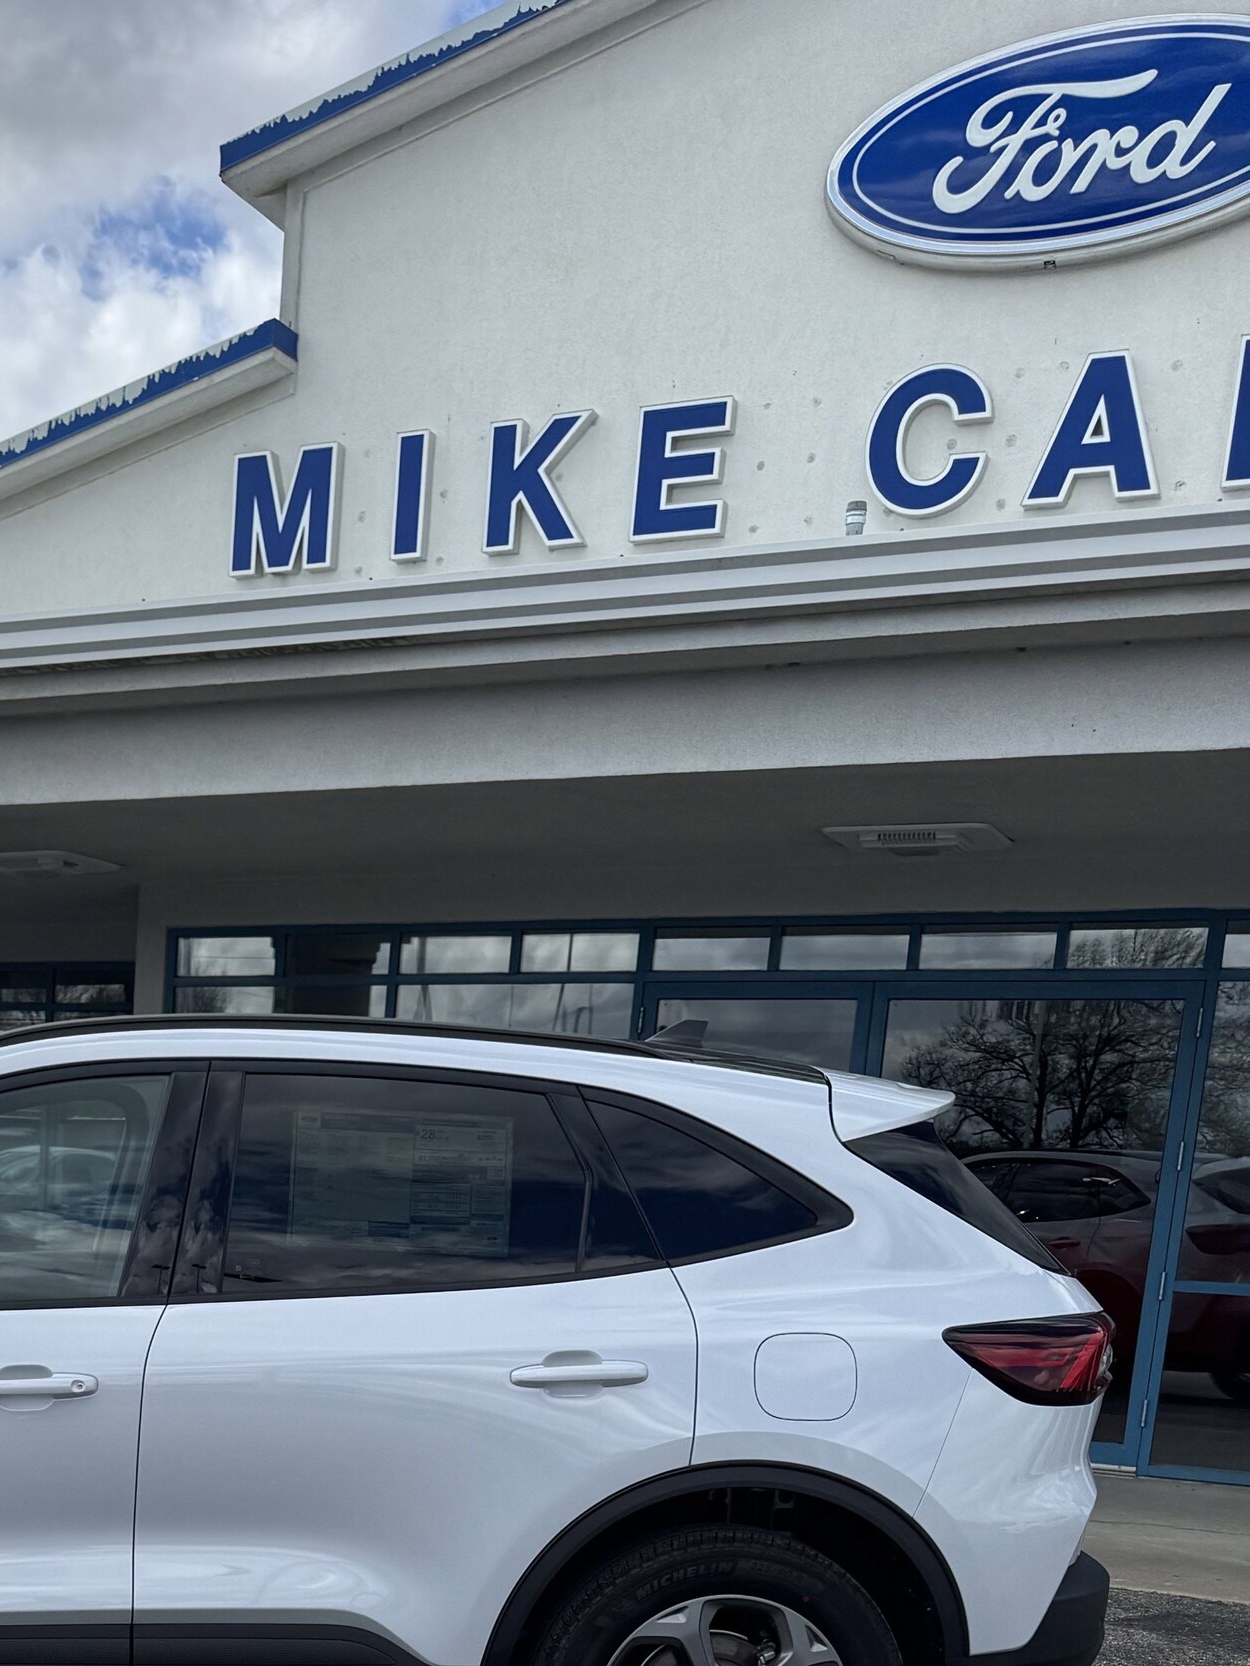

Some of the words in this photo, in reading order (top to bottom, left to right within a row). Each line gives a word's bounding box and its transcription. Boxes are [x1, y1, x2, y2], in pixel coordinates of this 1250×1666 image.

[932, 69, 1233, 214] Ford
[228, 394, 738, 578] MIKE
[635, 1560, 734, 1602] MICHELIN
